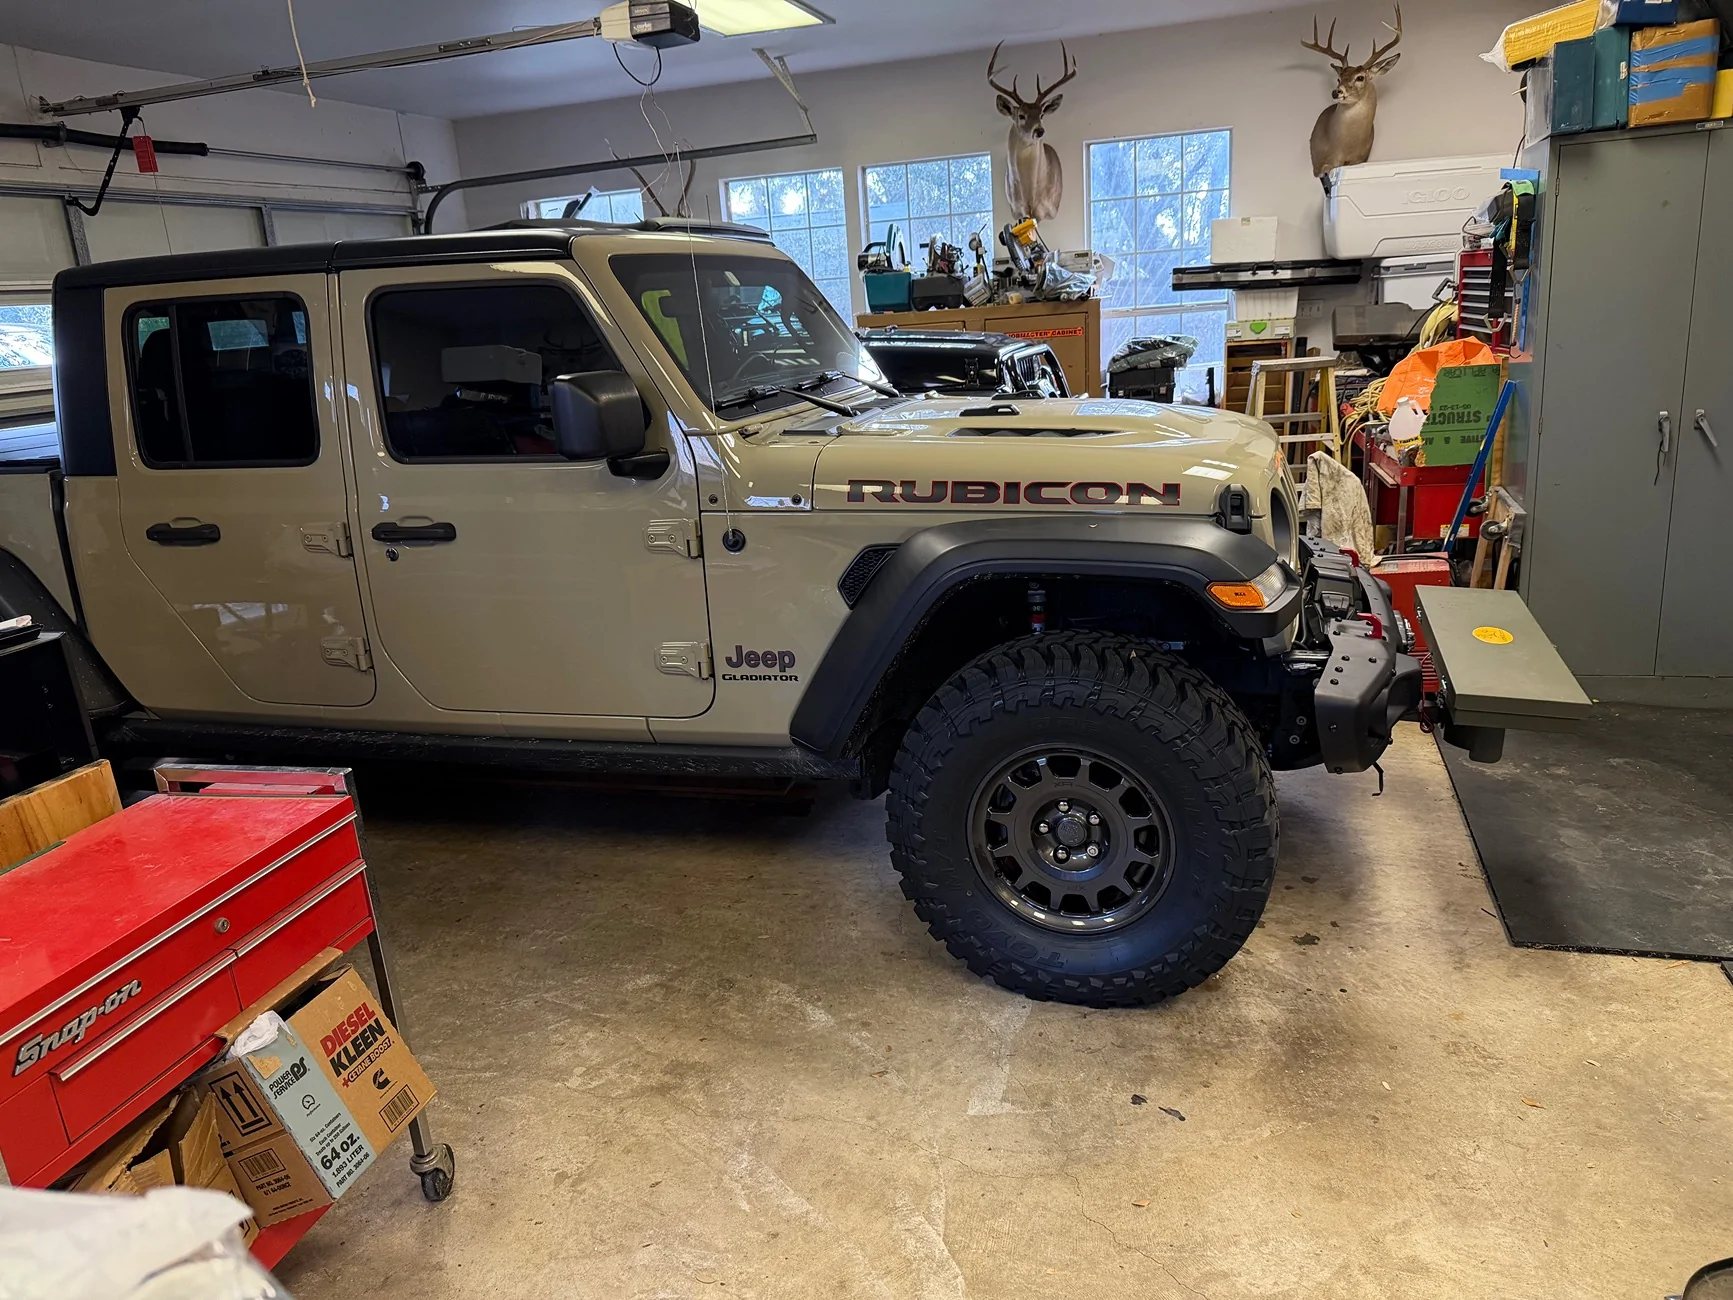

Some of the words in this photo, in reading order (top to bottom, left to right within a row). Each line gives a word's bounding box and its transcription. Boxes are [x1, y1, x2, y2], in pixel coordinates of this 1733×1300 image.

[1051, 328, 1082, 336] CABINET
[847, 479, 1181, 506] RUBICON
[725, 644, 796, 672] Jeep
[721, 673, 799, 682] GLADIATOR
[965, 907, 1065, 969] TOYO
[12, 979, 142, 1077] Snap-on
[319, 1001, 377, 1058] DIESEL
[329, 1017, 386, 1078] KLEEN
[370, 1038, 392, 1061] BOOST
[268, 1070, 292, 1093] POWER
[273, 1077, 297, 1100] SERVICE
[324, 1112, 342, 1129] Containers
[316, 1145, 328, 1157] Treats
[339, 1122, 351, 1134] Gallons
[318, 1136, 328, 1146] Each
[326, 1123, 342, 1138] Container
[320, 1146, 341, 1171] 64
[331, 1160, 348, 1178] 1.893
[345, 1144, 365, 1163] LITER
[336, 1174, 348, 1188] PART
[354, 1152, 370, 1170] 3064-06
[255, 1181, 267, 1191] PART
